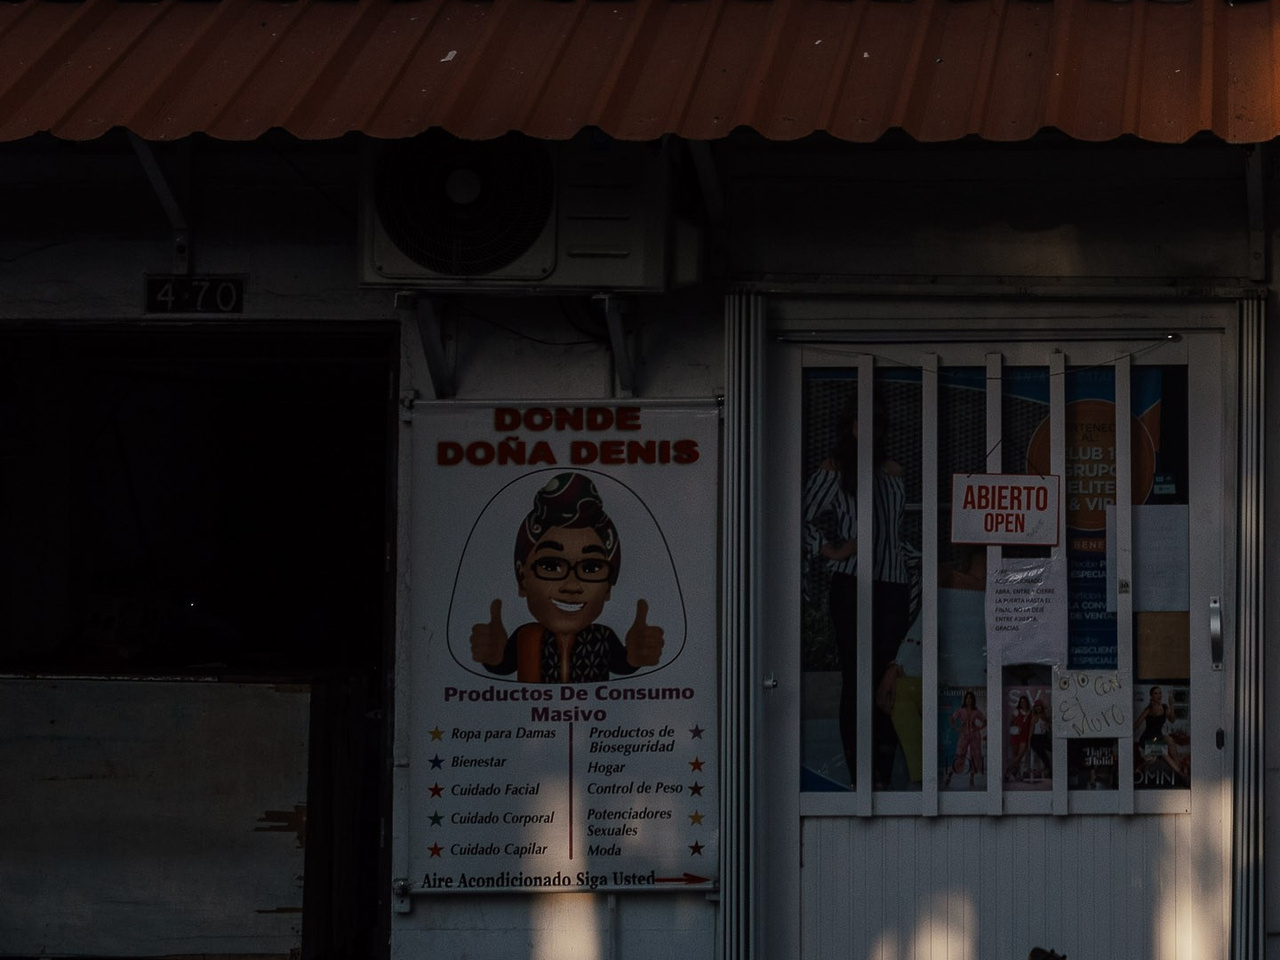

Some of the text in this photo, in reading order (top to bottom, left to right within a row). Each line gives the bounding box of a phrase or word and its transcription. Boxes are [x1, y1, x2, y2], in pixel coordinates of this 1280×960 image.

[156, 279, 236, 311] 470
[495, 407, 641, 431] DONDE
[438, 436, 700, 466] DOÑA DENIS
[1067, 481, 1115, 494] ELITE
[963, 485, 1047, 511] ABIERTO
[985, 513, 1025, 532] OPEN
[445, 686, 694, 701] Productos De Consumo
[531, 706, 607, 722] Masivo
[452, 727, 555, 742] Ropa para Damas
[589, 725, 674, 738] Productos de
[590, 740, 675, 756] Bioseguridad
[452, 755, 507, 767] Bienestar
[588, 762, 625, 776] Hogar
[451, 783, 540, 796] Cuidado Facial
[588, 781, 683, 794] Control de Peso
[451, 811, 554, 827] Cuidado Corporal
[587, 807, 671, 820] Potenciadores
[587, 824, 637, 836] Sexuales
[451, 843, 547, 858] Cuidado Capilar
[588, 843, 621, 856] Moda
[421, 871, 655, 889] Aire Acondicionado Siga Usted
